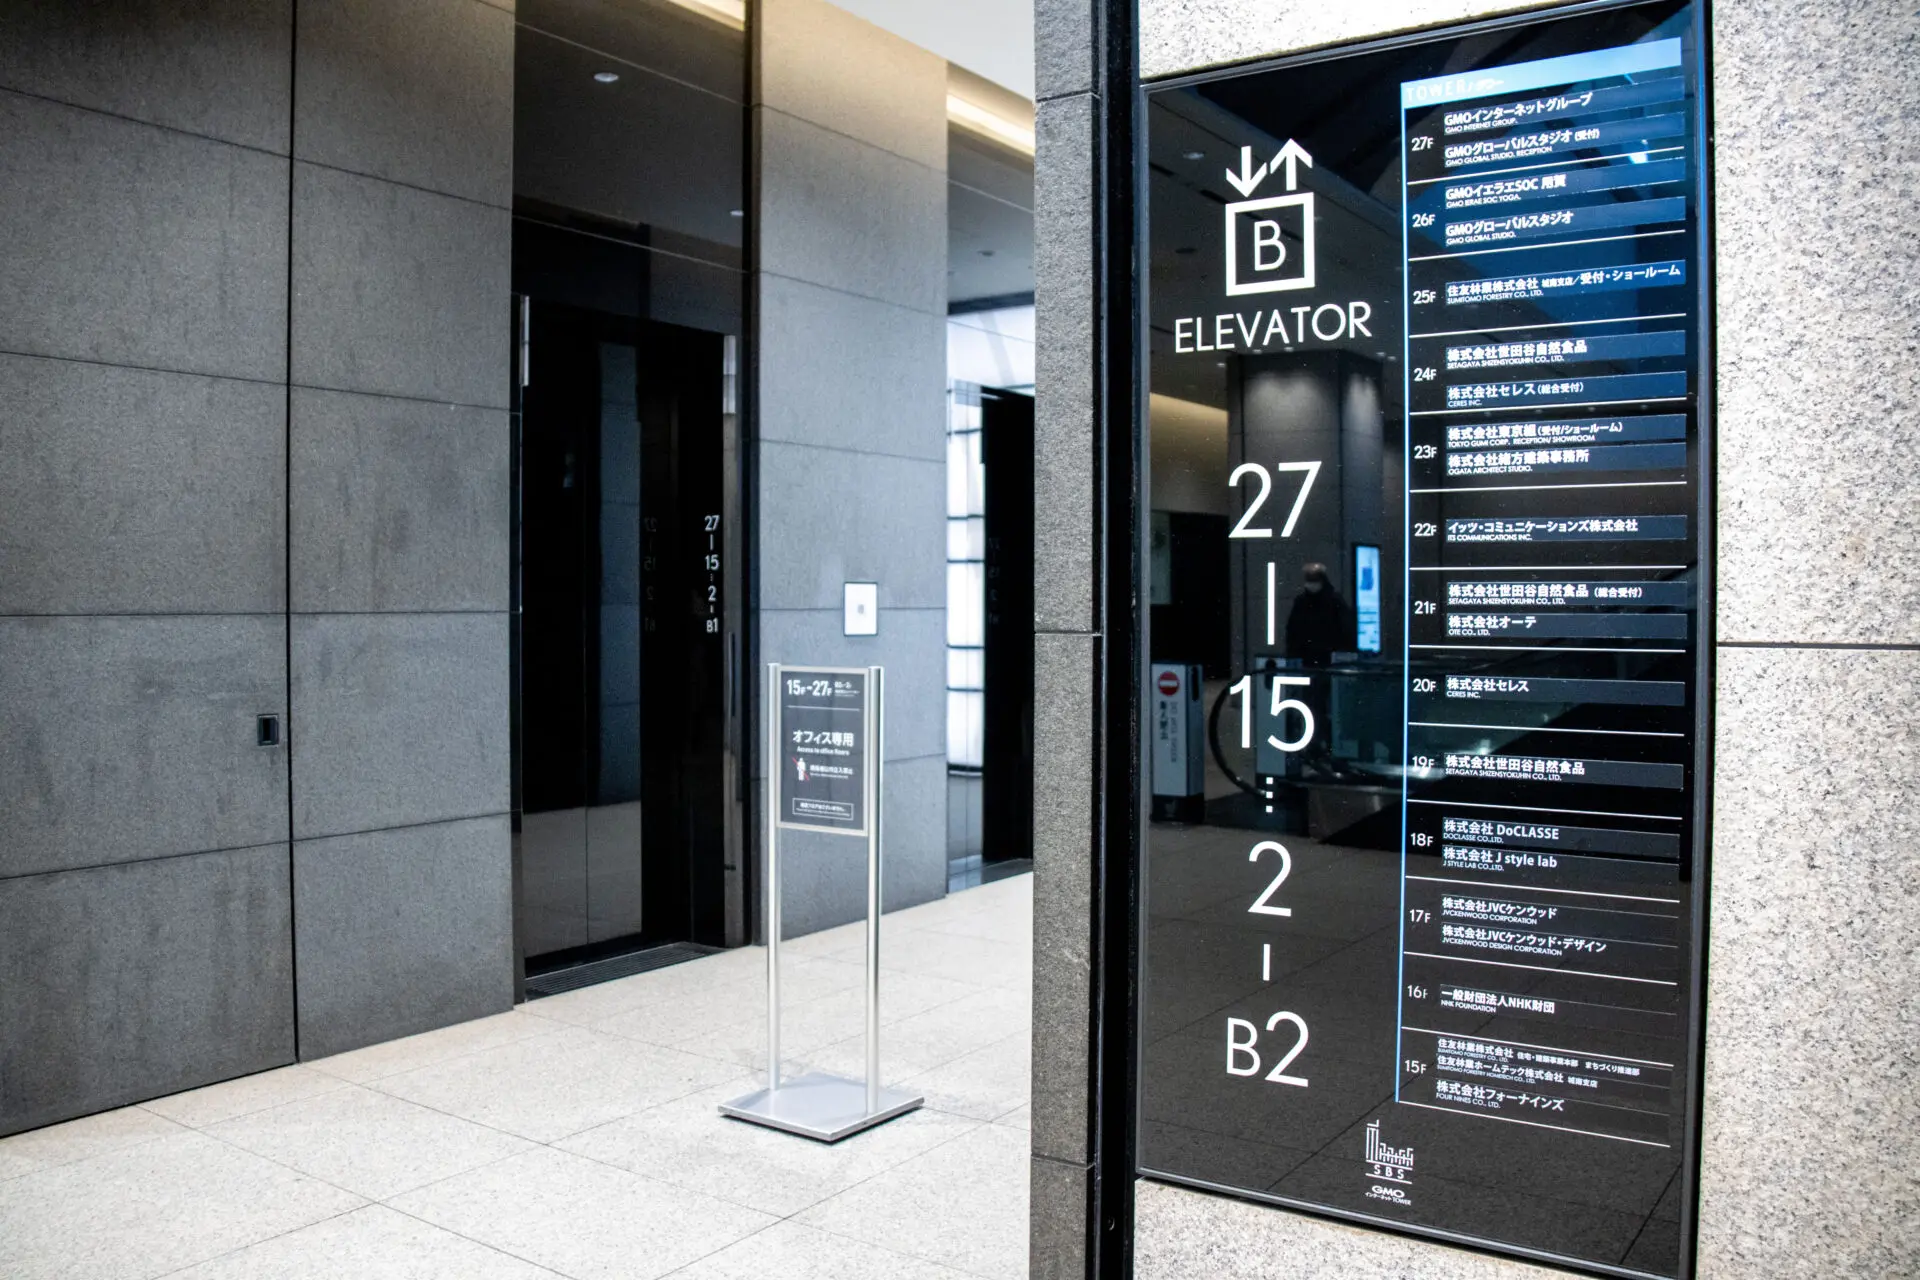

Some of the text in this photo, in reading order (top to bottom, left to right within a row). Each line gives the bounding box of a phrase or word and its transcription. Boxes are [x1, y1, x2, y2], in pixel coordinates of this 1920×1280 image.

[1411, 136, 1434, 151] 27F
[1412, 213, 1435, 228] 26F
[1254, 220, 1286, 271] B
[1413, 290, 1436, 304] 25F
[1175, 301, 1372, 353] ELEVATOR
[1413, 368, 1437, 382] 24F
[1414, 445, 1437, 460] 23F
[1228, 461, 1322, 538] 27
[704, 515, 720, 531] 27
[1414, 522, 1437, 537] 22F
[705, 554, 720, 570] 15
[708, 585, 717, 602] 2
[1414, 601, 1436, 615] 21F
[706, 618, 719, 633] B1
[1413, 678, 1436, 692] 20F
[1230, 675, 1315, 752] 15
[1412, 756, 1435, 769] 19F
[1410, 833, 1434, 847] 18F
[1247, 840, 1292, 917] 2
[1409, 909, 1431, 924] 17F
[1406, 984, 1428, 1000] 16F
[1226, 1010, 1309, 1088] B2
[1404, 1060, 1426, 1074] 15F
[1374, 1164, 1404, 1180] SBS
[1372, 1185, 1405, 1198] GMO
